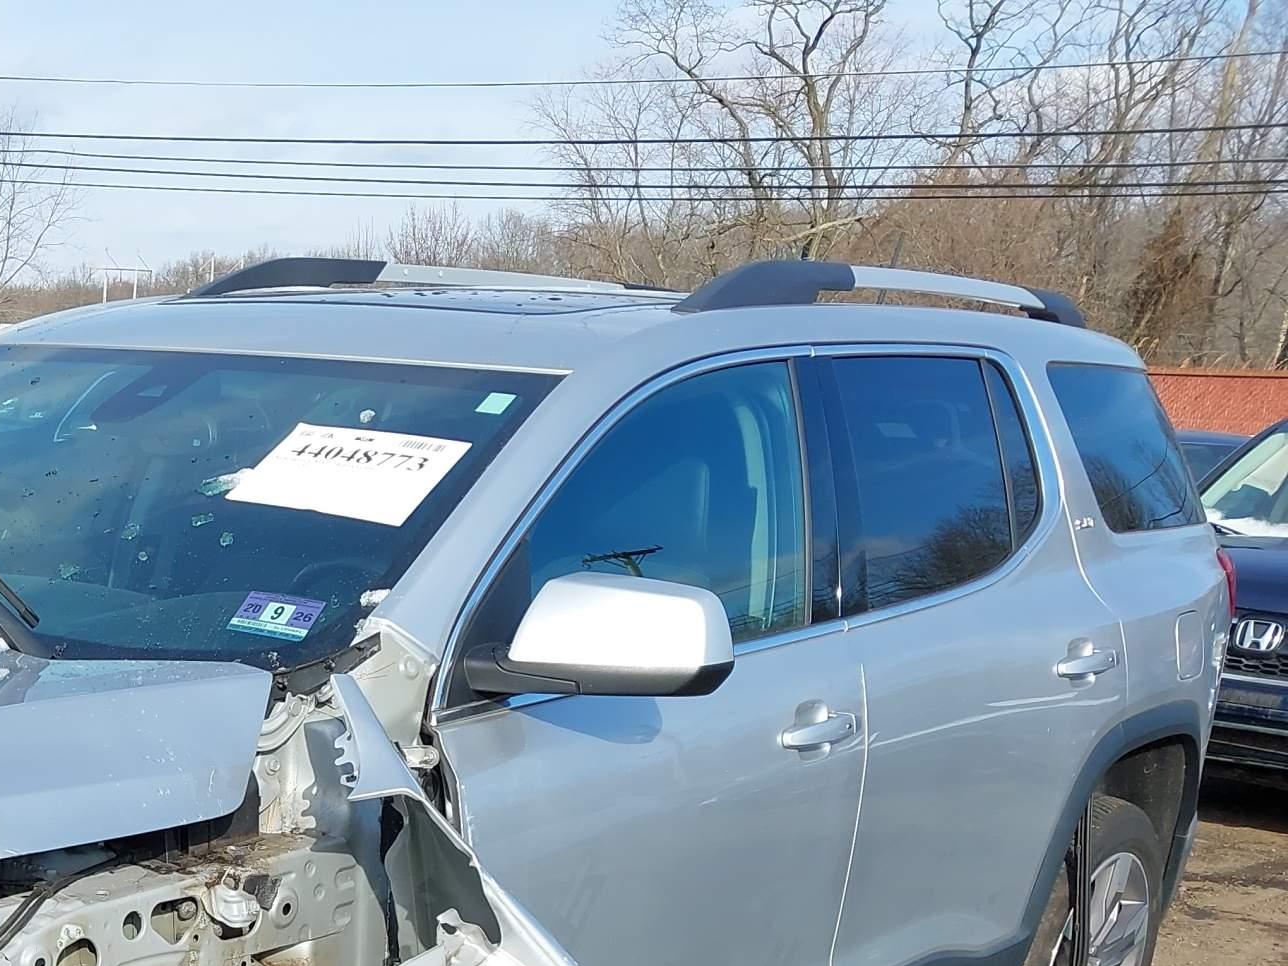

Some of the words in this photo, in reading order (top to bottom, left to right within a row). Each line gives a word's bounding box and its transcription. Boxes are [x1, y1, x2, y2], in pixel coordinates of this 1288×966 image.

[291, 443, 429, 473] 44048773
[243, 602, 262, 614] 20
[269, 605, 286, 621] 9
[292, 611, 314, 623] 26
